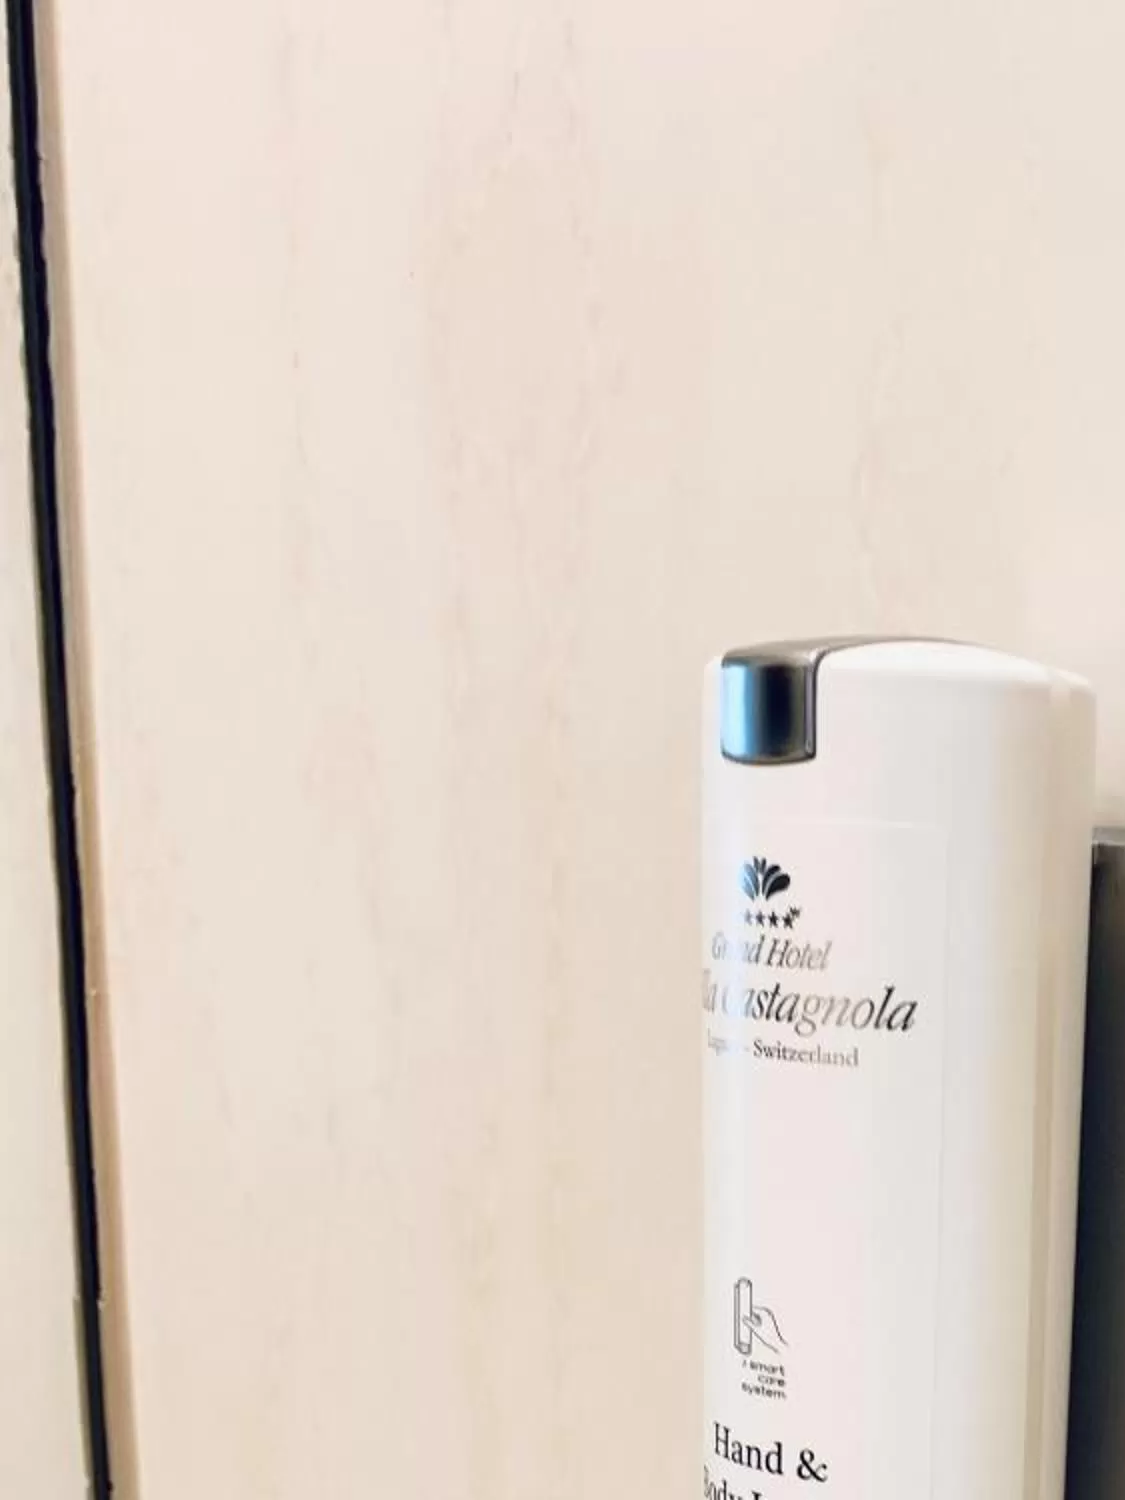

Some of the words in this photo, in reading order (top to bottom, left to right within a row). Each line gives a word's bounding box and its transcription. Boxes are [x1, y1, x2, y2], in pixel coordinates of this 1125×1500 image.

[766, 937, 833, 972] Hotel
[753, 1038, 859, 1068] Switzerland
[750, 1360, 785, 1377] smart
[741, 1381, 787, 1400] system
[757, 1374, 787, 1388] care
[713, 1420, 784, 1477] Hand
[796, 1448, 829, 1483] &
